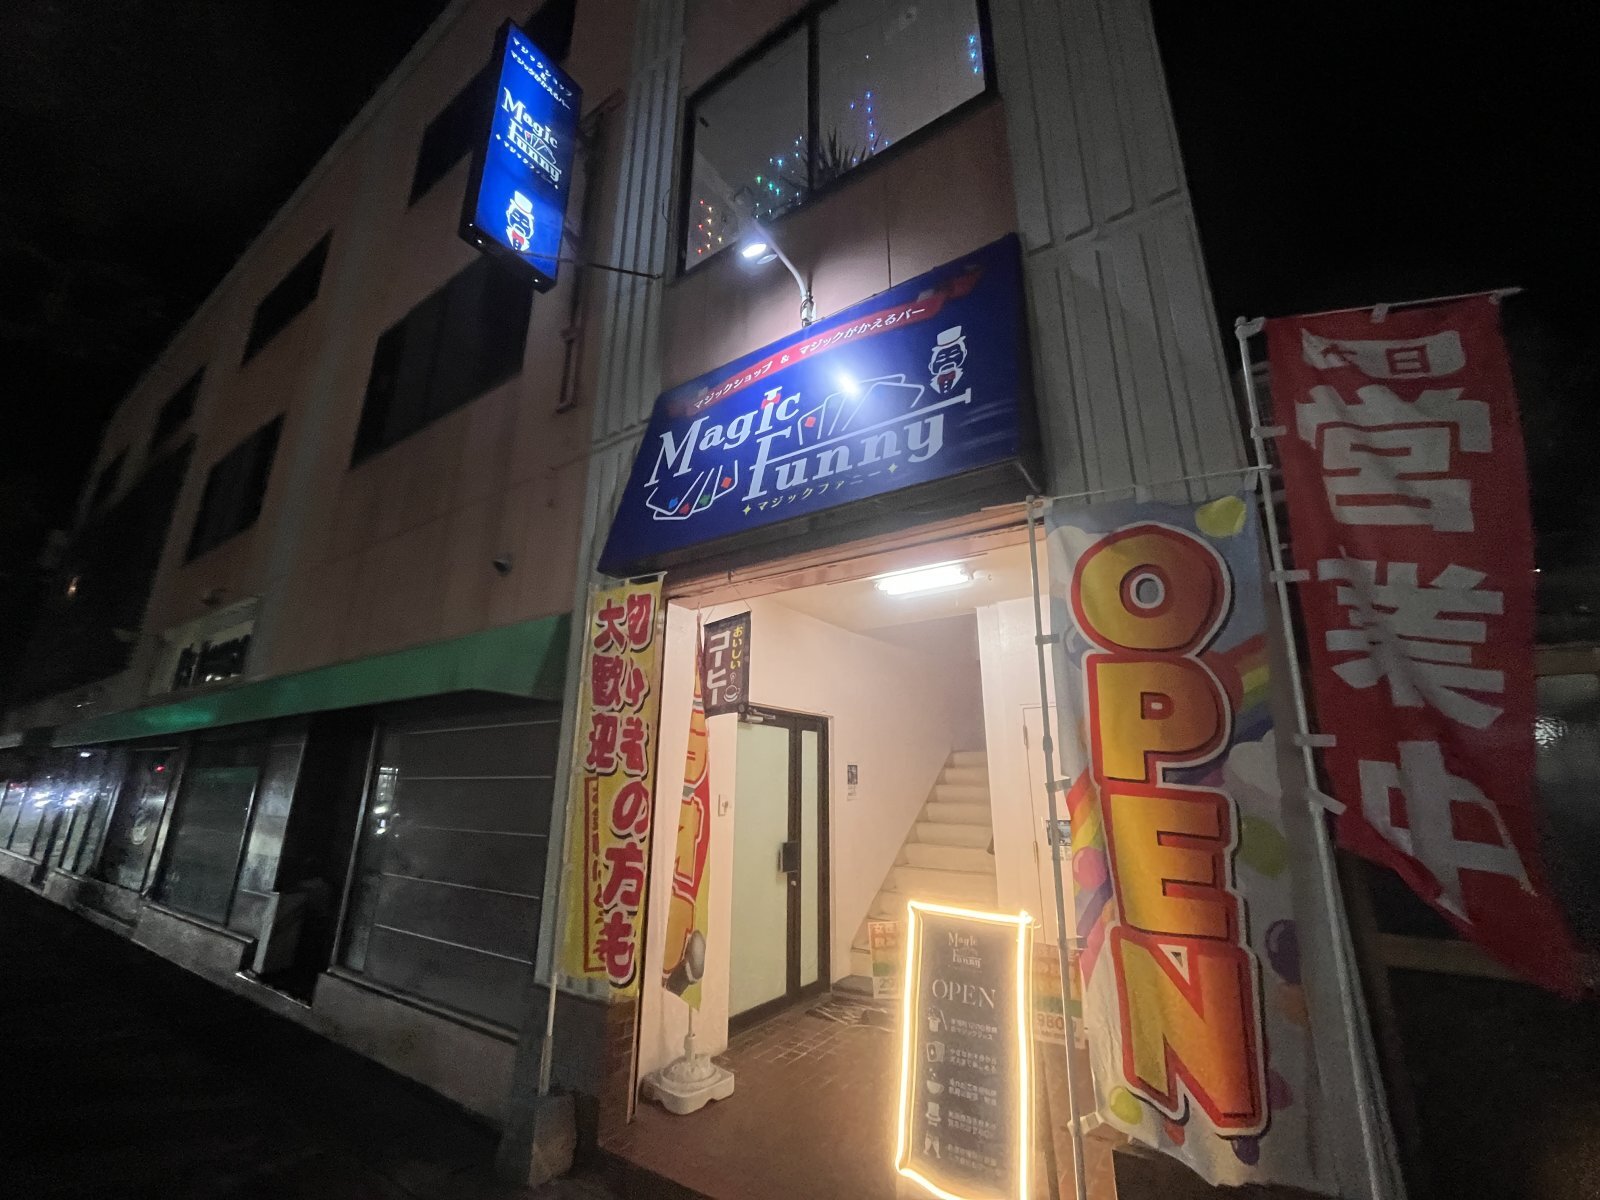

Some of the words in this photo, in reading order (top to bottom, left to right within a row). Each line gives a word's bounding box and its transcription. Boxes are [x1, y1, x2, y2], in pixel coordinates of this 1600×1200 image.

[501, 86, 558, 149] Magic
[507, 118, 562, 183] Funny
[694, 361, 774, 409] マジックショップ
[779, 354, 791, 365] &
[799, 308, 926, 354] マジックがかえるバー
[643, 385, 801, 488] Magic
[741, 388, 972, 502] Funny
[758, 471, 881, 512] マジックファニー
[706, 629, 732, 706] コーヒー
[730, 624, 745, 671] おいしい
[1296, 384, 1536, 925] 営業中
[1070, 521, 1271, 1138] OPEN
[948, 931, 978, 954] Magic
[932, 978, 997, 1009] OPEN
